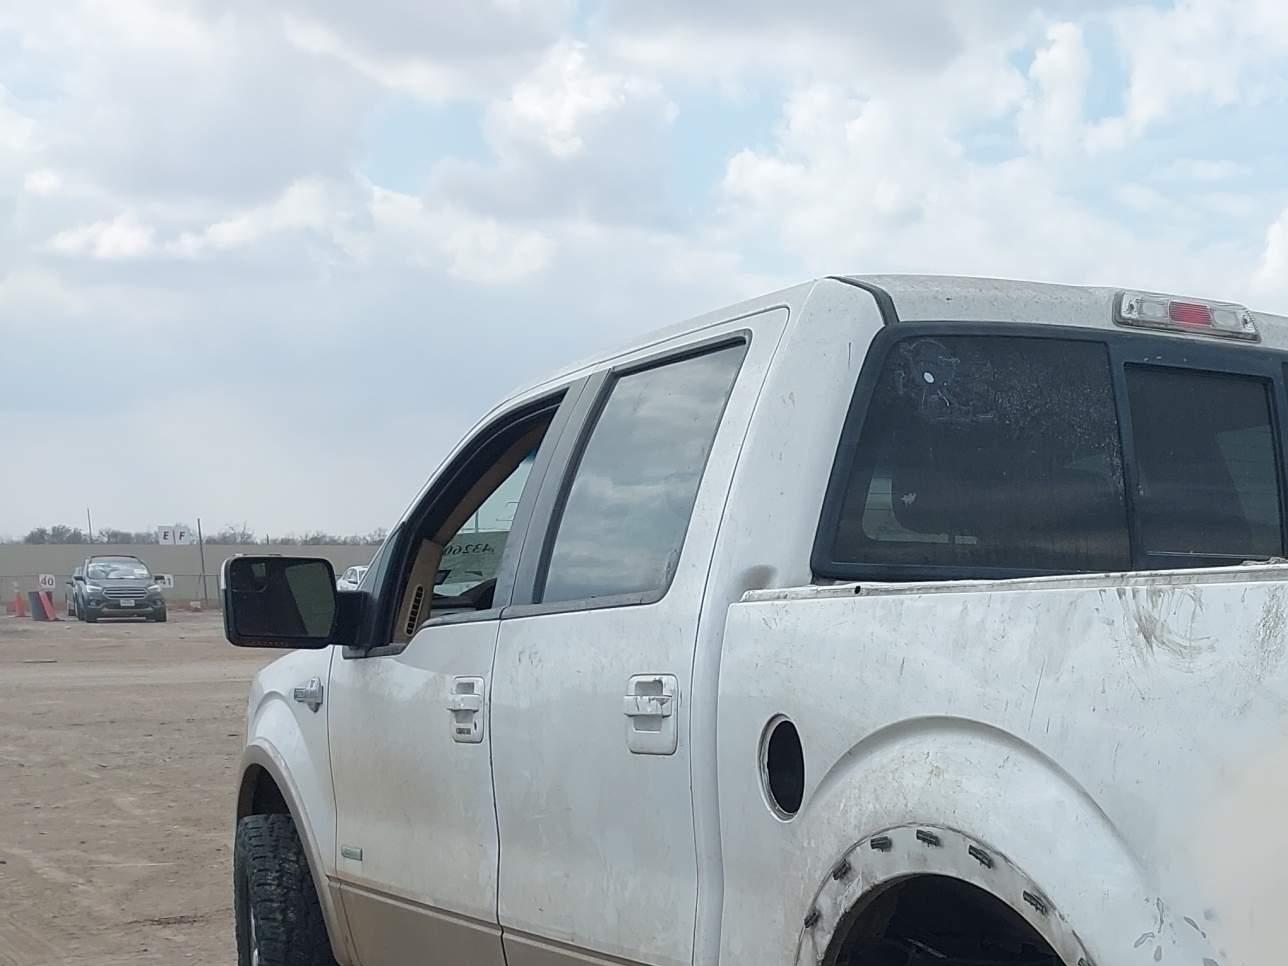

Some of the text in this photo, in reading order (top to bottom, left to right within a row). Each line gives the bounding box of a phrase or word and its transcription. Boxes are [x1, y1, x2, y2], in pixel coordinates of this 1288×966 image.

[163, 531, 185, 541] E F
[40, 575, 54, 586] 40
